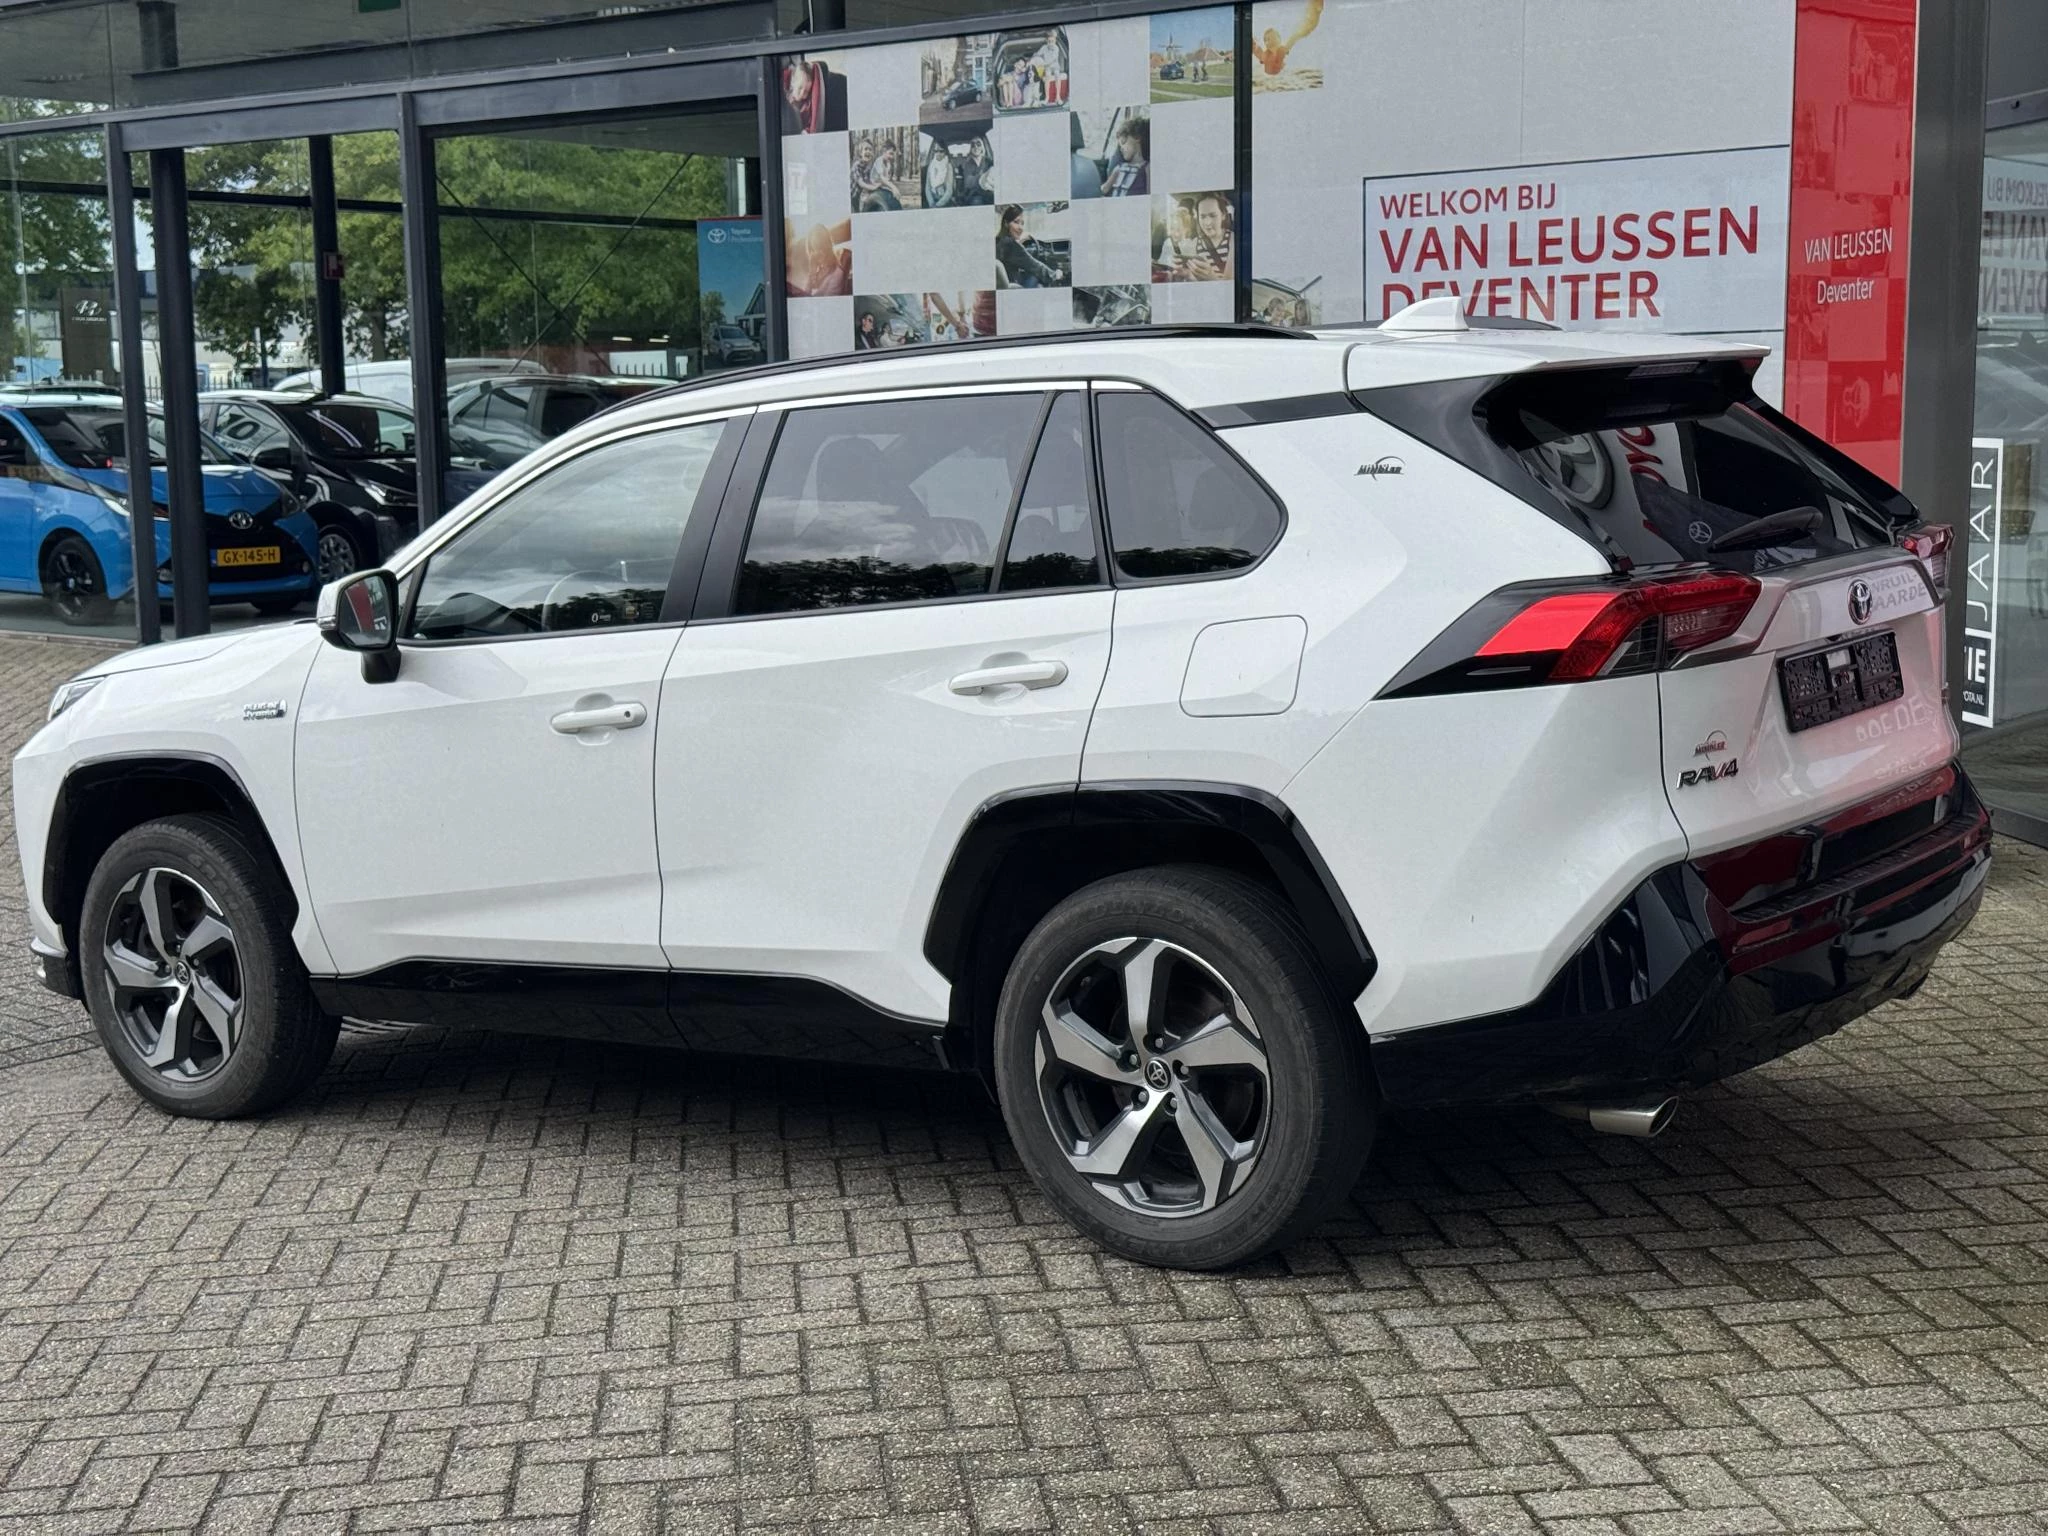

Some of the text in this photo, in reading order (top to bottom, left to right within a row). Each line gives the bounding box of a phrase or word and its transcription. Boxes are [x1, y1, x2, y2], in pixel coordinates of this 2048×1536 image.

[1379, 183, 1556, 220] WELKOM BIJ
[1379, 205, 1759, 274] VAN LEUSSEN
[1804, 226, 1893, 264] VAN LEUSSEN
[1817, 277, 1874, 305] Deventer
[223, 548, 276, 564] GX-145-H
[1966, 458, 1994, 623] JAAR
[1676, 758, 1738, 790] RAV4
